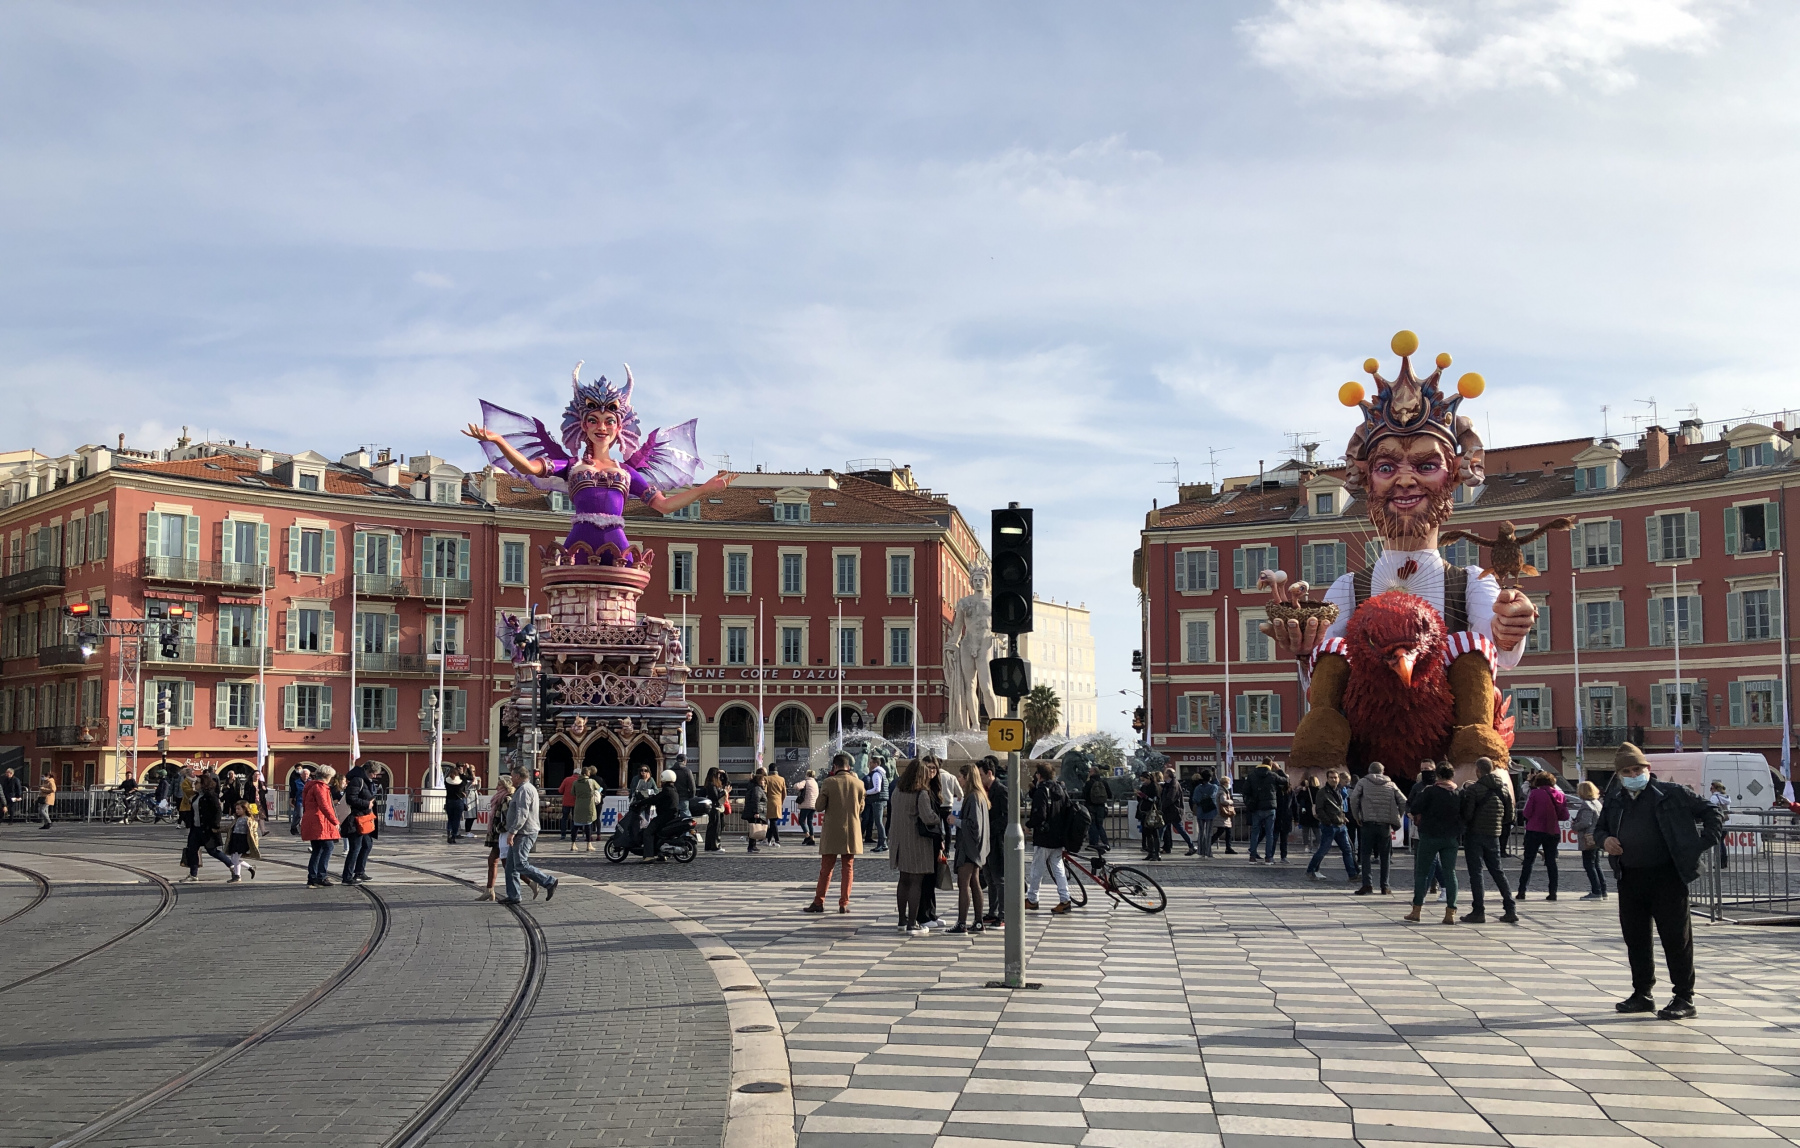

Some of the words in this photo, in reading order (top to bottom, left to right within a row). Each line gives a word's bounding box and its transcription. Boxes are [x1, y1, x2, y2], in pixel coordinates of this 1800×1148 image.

[740, 669, 778, 679] COTE
[792, 669, 846, 679] D'AZUR
[1746, 681, 1770, 691] HOTEL
[1518, 689, 1538, 698] HOTEL
[1590, 688, 1613, 697] HOTEL
[998, 728, 1015, 741] 15
